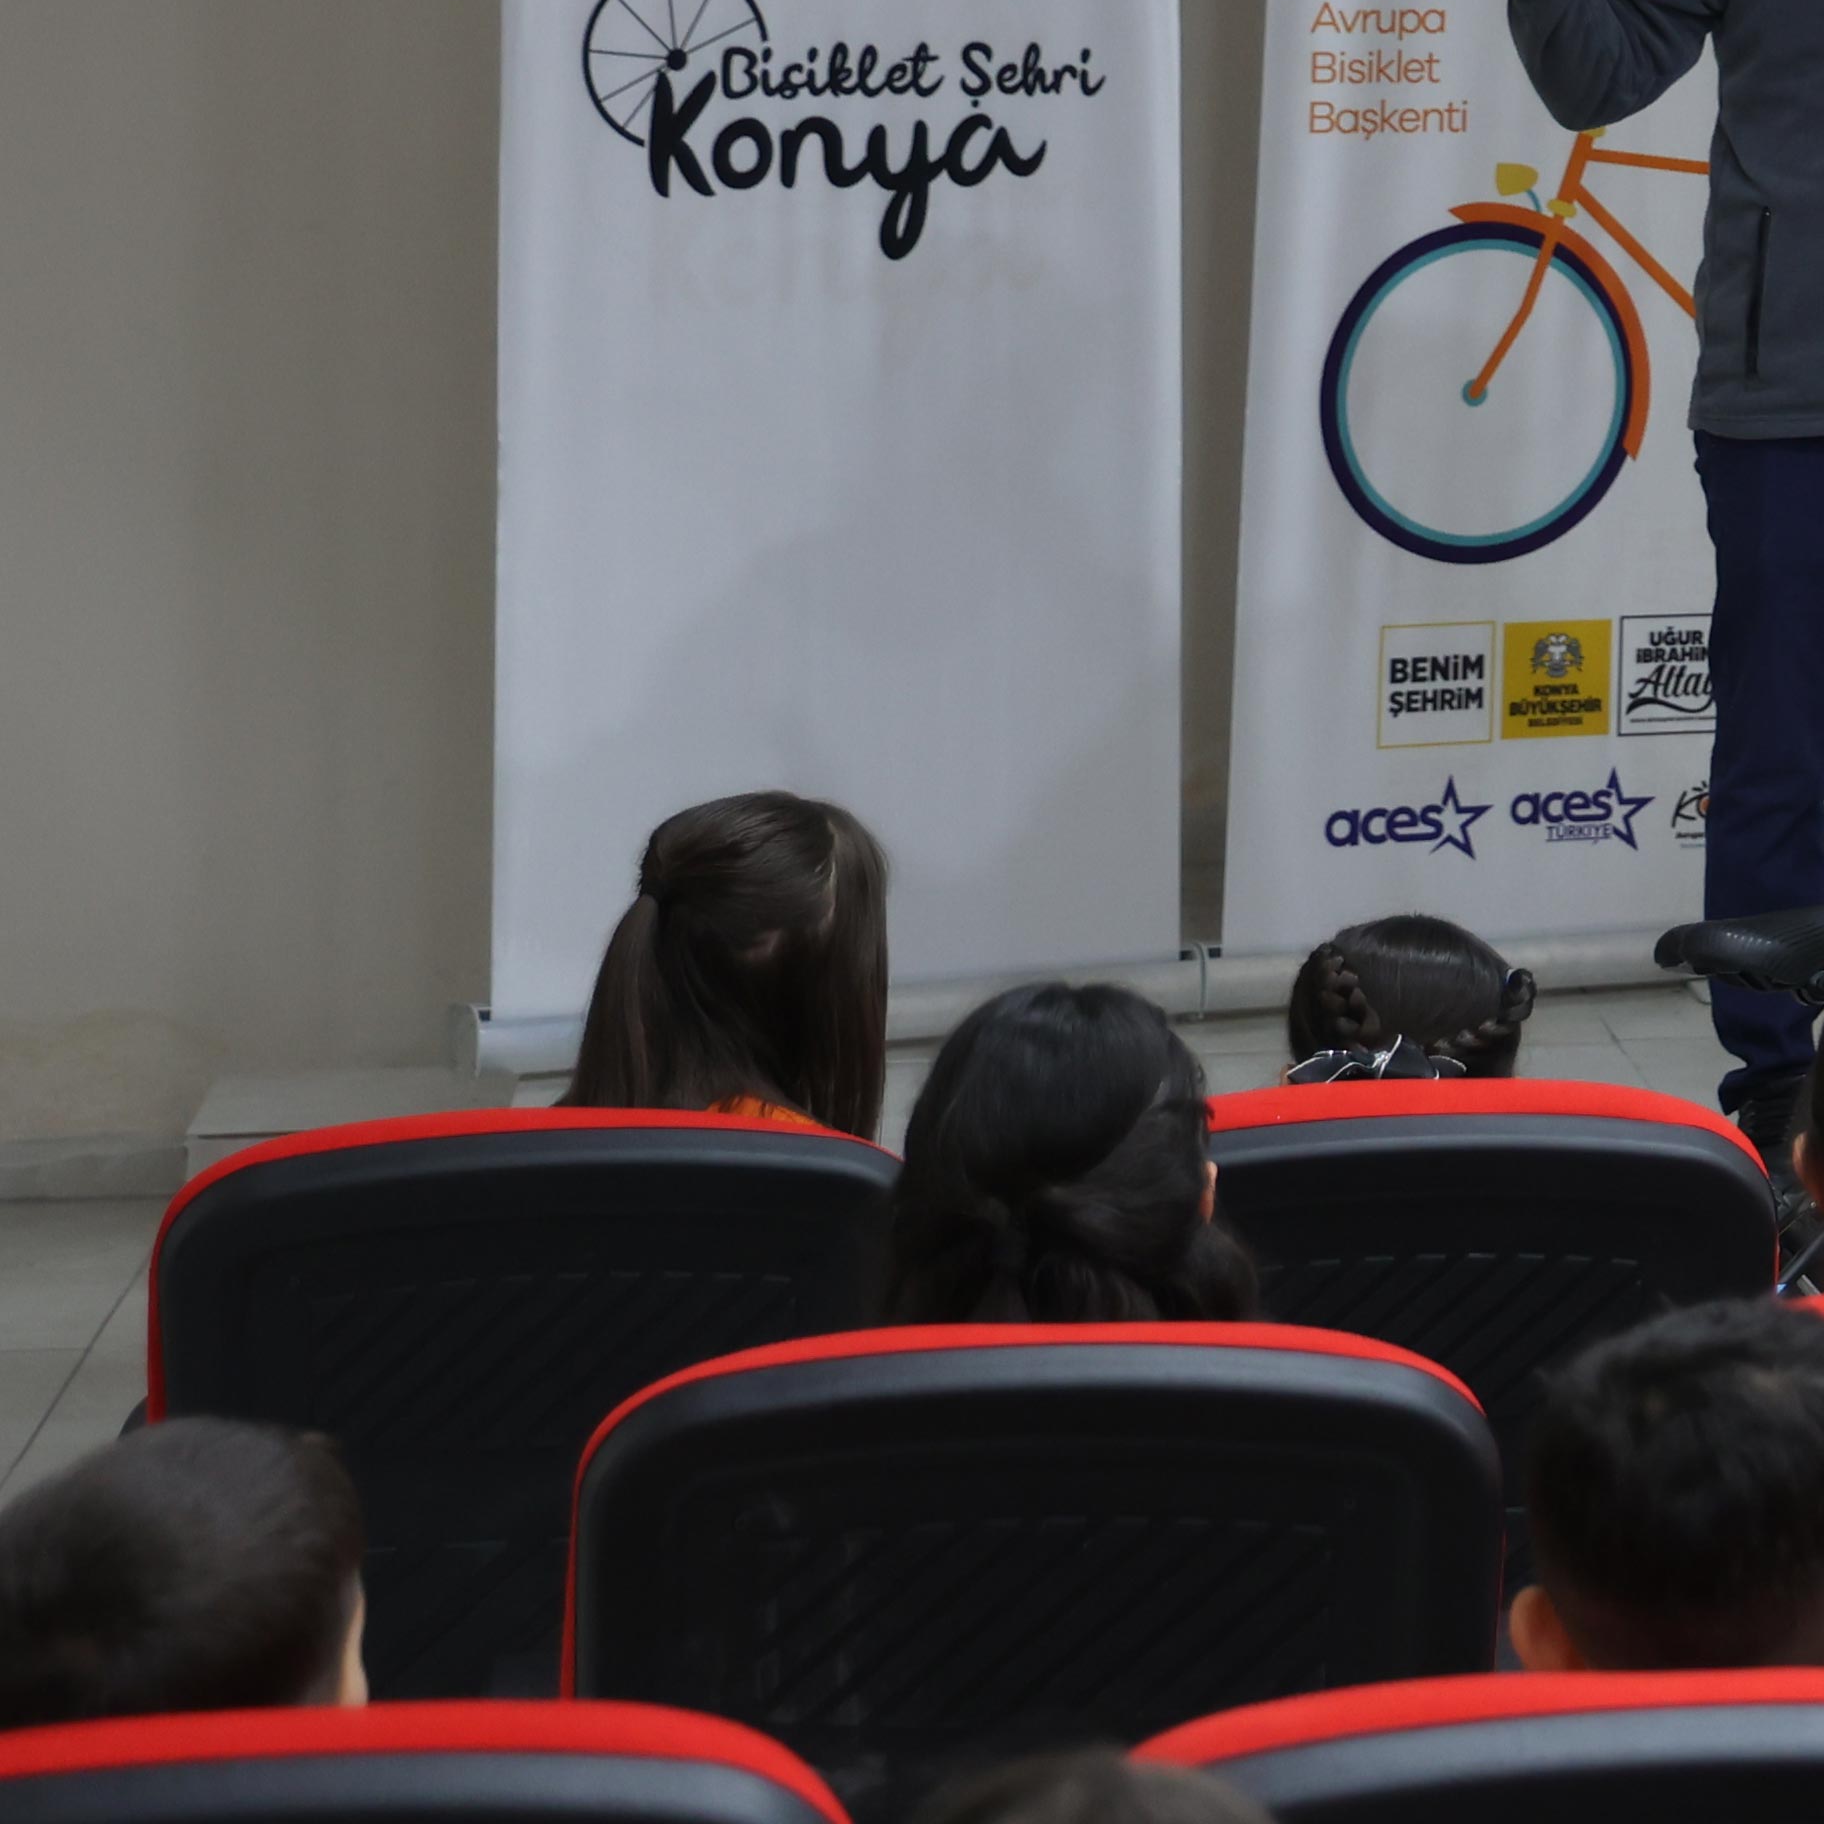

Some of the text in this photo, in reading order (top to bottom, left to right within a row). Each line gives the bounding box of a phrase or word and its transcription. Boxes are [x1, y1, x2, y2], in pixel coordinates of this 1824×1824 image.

[1310, 2, 1447, 40] Avrupa
[721, 42, 1106, 108] Bisiklet Şehri
[1310, 50, 1441, 84] Bisiklet
[1308, 101, 1469, 140] Başkenti
[648, 70, 1047, 261] Konya
[1649, 626, 1704, 646] UĞUR
[1509, 696, 1602, 716] BÜYÜKŞEHİR
[1534, 683, 1579, 696] KONYA
[1325, 802, 1444, 847] aces
[1511, 787, 1613, 825] aces
